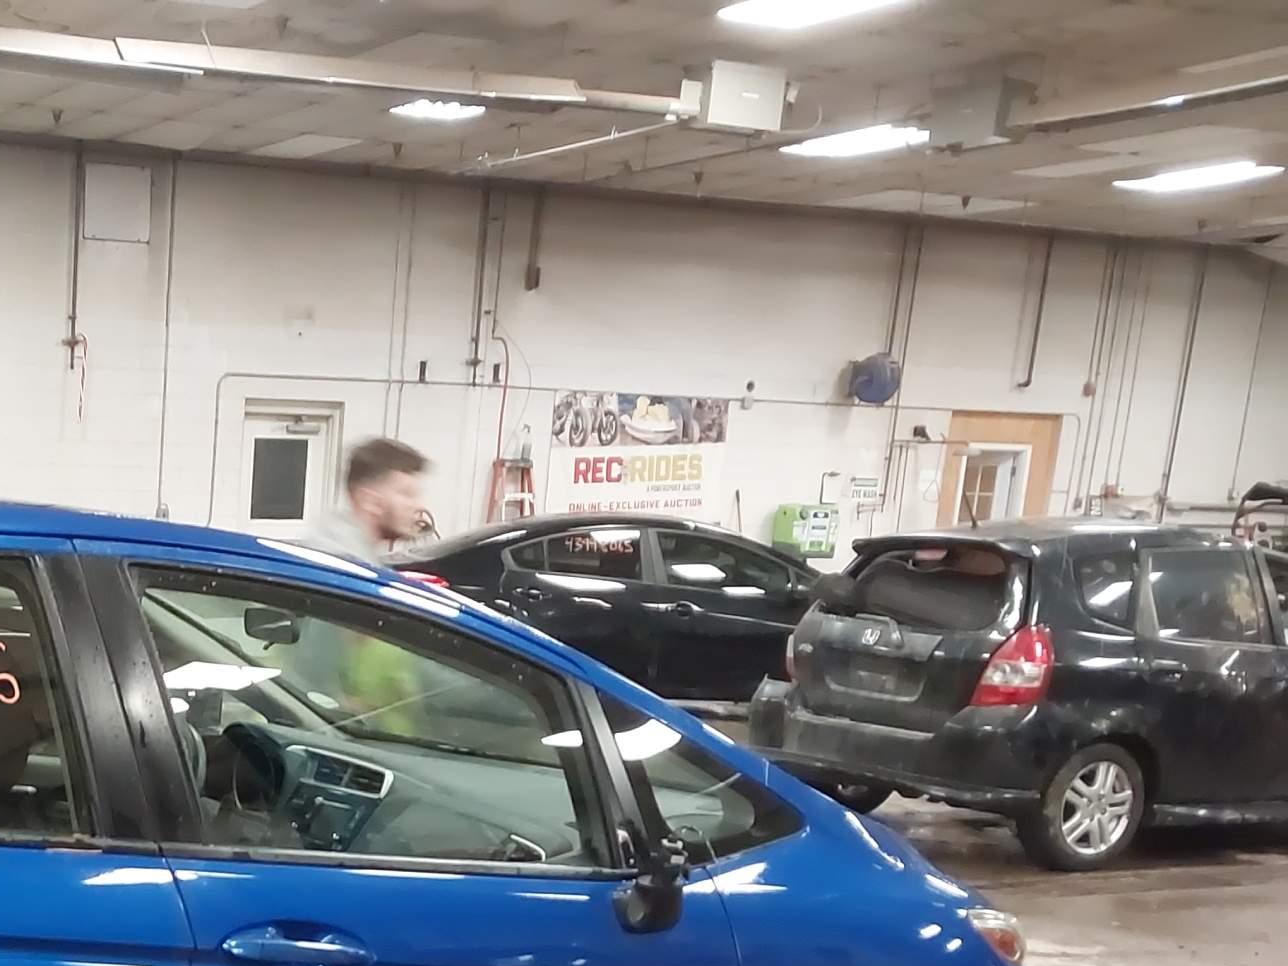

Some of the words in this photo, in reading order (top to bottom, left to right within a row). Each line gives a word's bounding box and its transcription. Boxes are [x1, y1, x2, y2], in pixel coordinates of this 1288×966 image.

[573, 456, 624, 484] REC
[629, 453, 704, 483] RIDES
[568, 500, 660, 512] ONLINE-EXCLUSIVE
[663, 498, 703, 509] AUCTION
